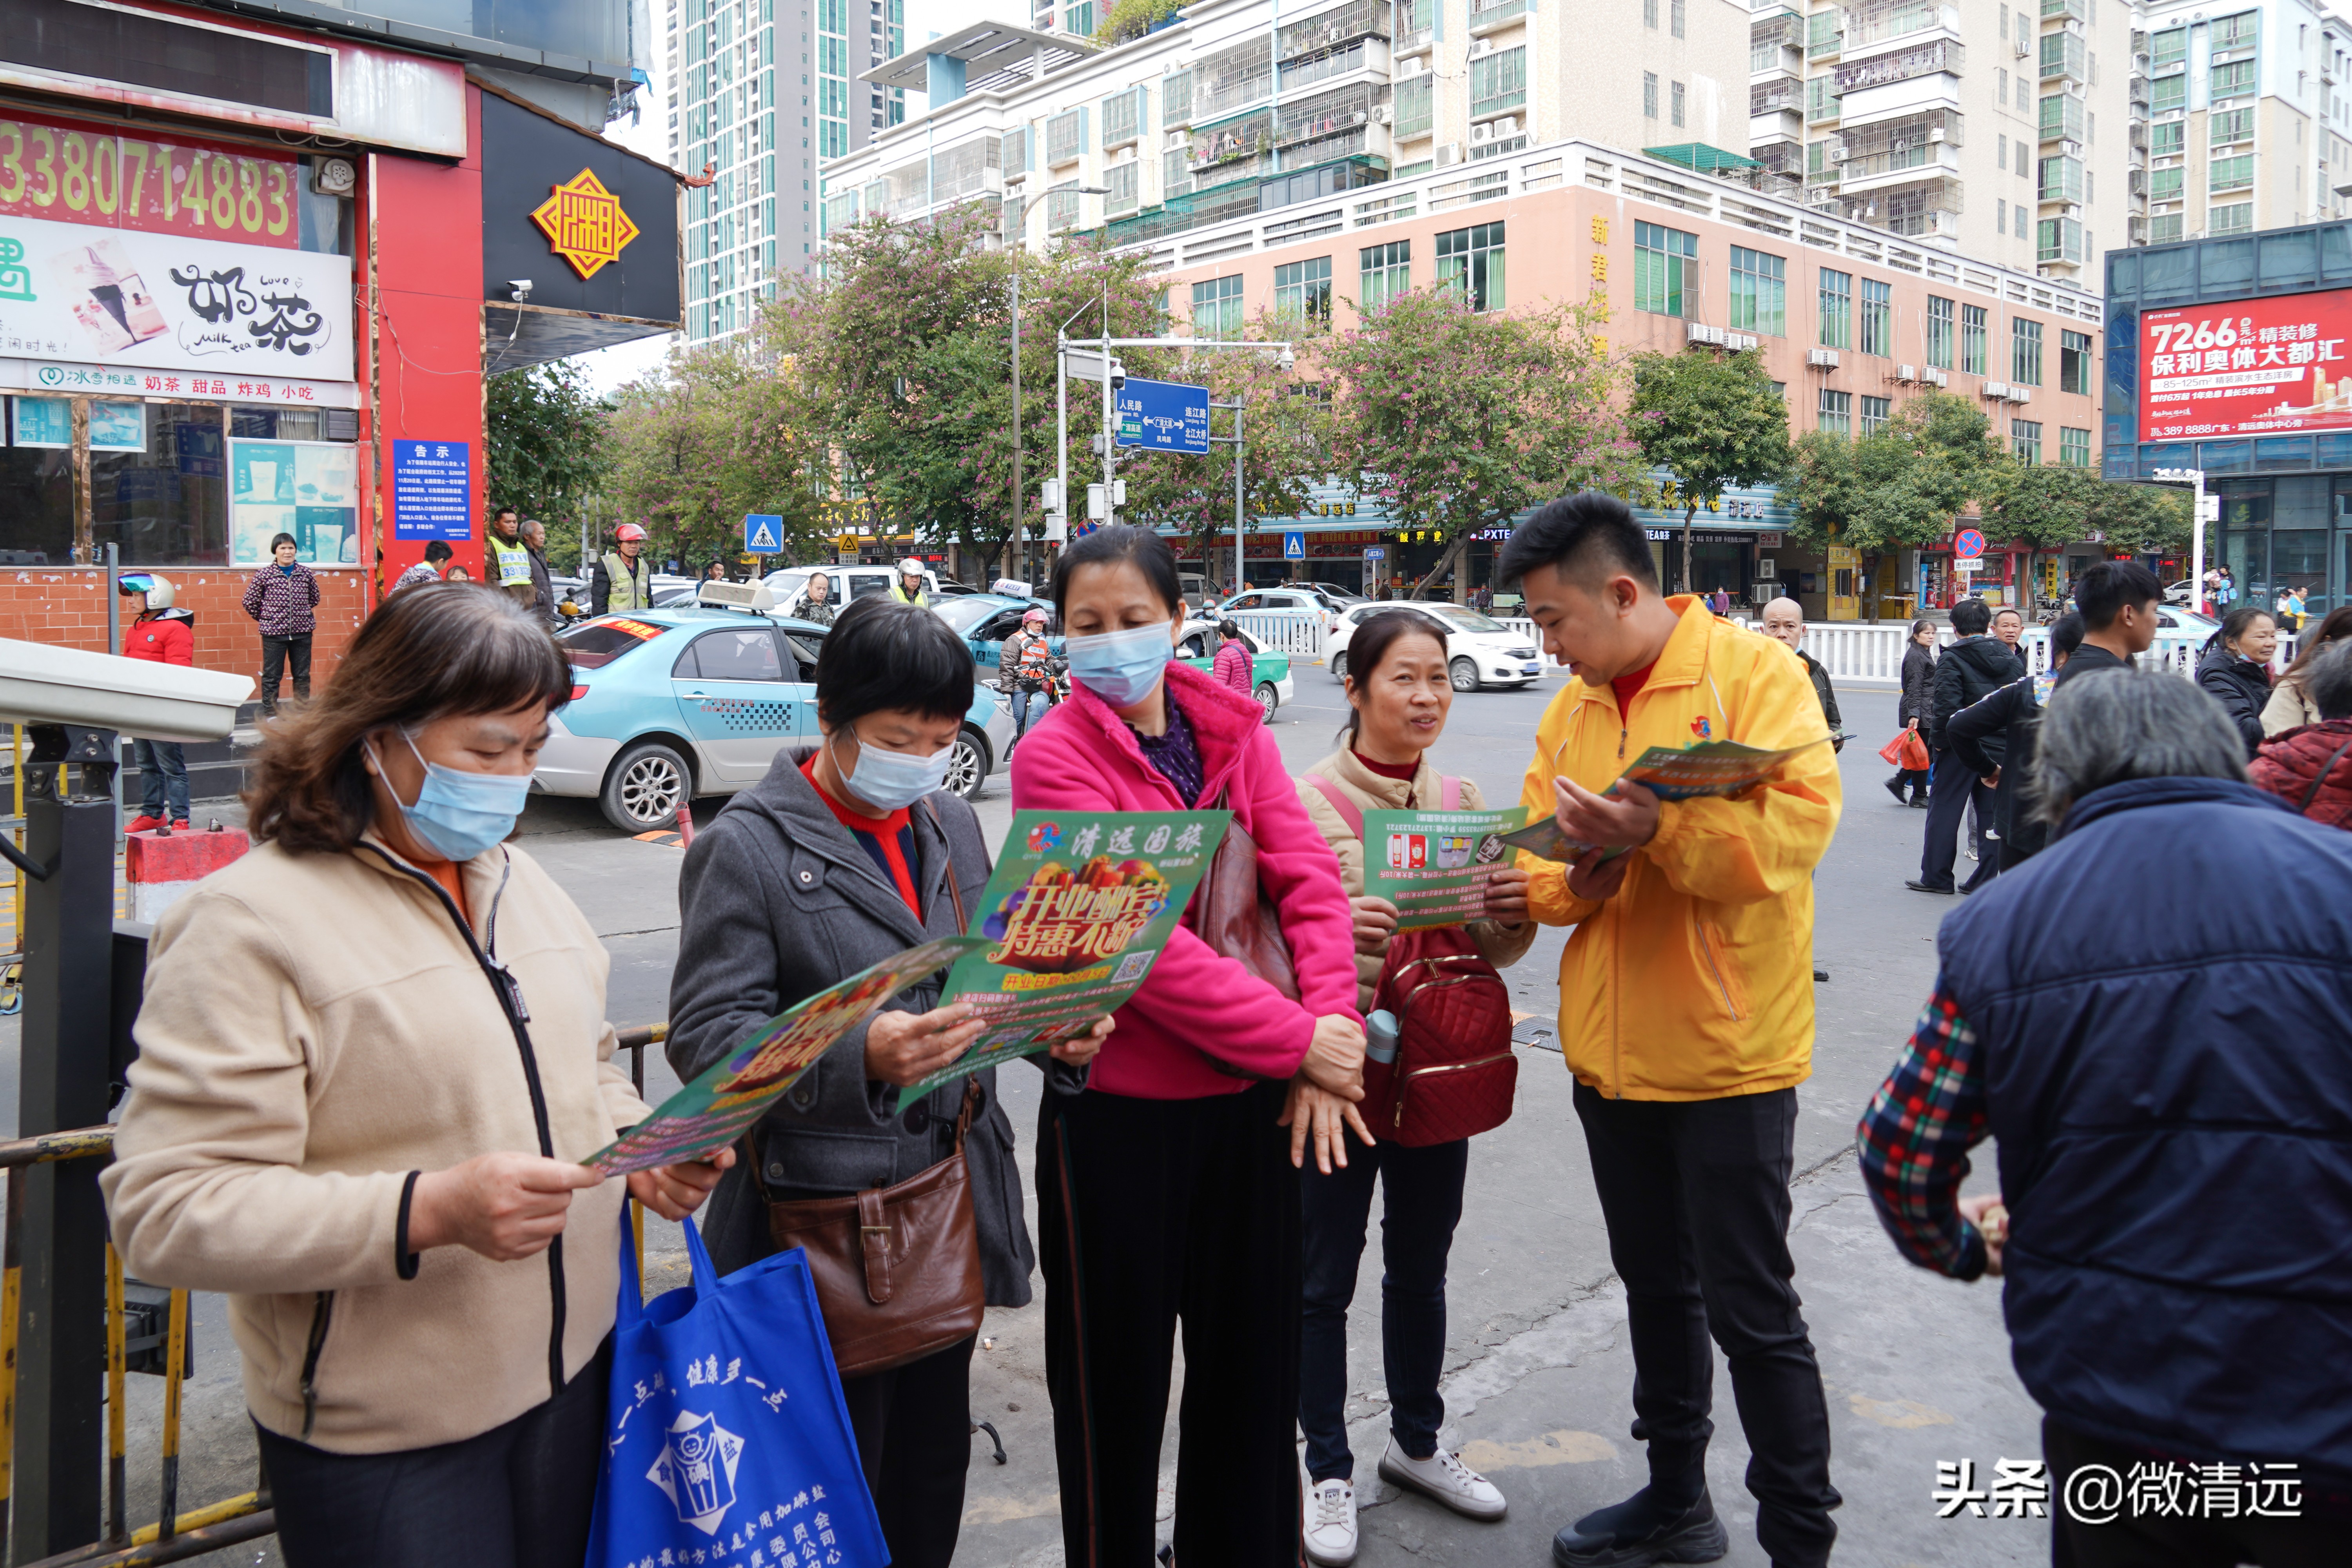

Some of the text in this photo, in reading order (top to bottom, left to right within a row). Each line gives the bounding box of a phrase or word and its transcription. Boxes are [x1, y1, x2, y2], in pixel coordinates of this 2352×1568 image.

[194, 333, 252, 352] Milk tea
[2151, 318, 2237, 353] 7266
[2259, 323, 2318, 344] 精装修
[0, 337, 67, 352] 闲时光！
[2151, 339, 2345, 377] 保利奥体大都汇
[2216, 370, 2293, 385] 精装滨水生态洋房
[145, 375, 180, 392] 奶茶
[192, 378, 226, 395] 甜品
[238, 382, 270, 398] 炸鸡
[281, 385, 314, 400] 小吃
[2151, 385, 2276, 403] 首付6万起 1年免息 最长5年分期
[1120, 399, 1142, 412] 人民路
[1185, 407, 1207, 419] 连江路
[1121, 423, 1142, 433] 广清高速
[1156, 419, 1172, 427] 广清大道
[2164, 426, 2183, 436] 389
[2185, 424, 2212, 434] 8888
[1185, 428, 1207, 440] 北江大桥
[415, 445, 449, 458] 告示
[1319, 502, 1355, 515] 清远店
[1071, 822, 1204, 859] 清远国旅
[1016, 882, 1163, 921] 开业酬宾
[987, 913, 1151, 963] 特惠不断
[729, 1512, 830, 1568] 康委员会
